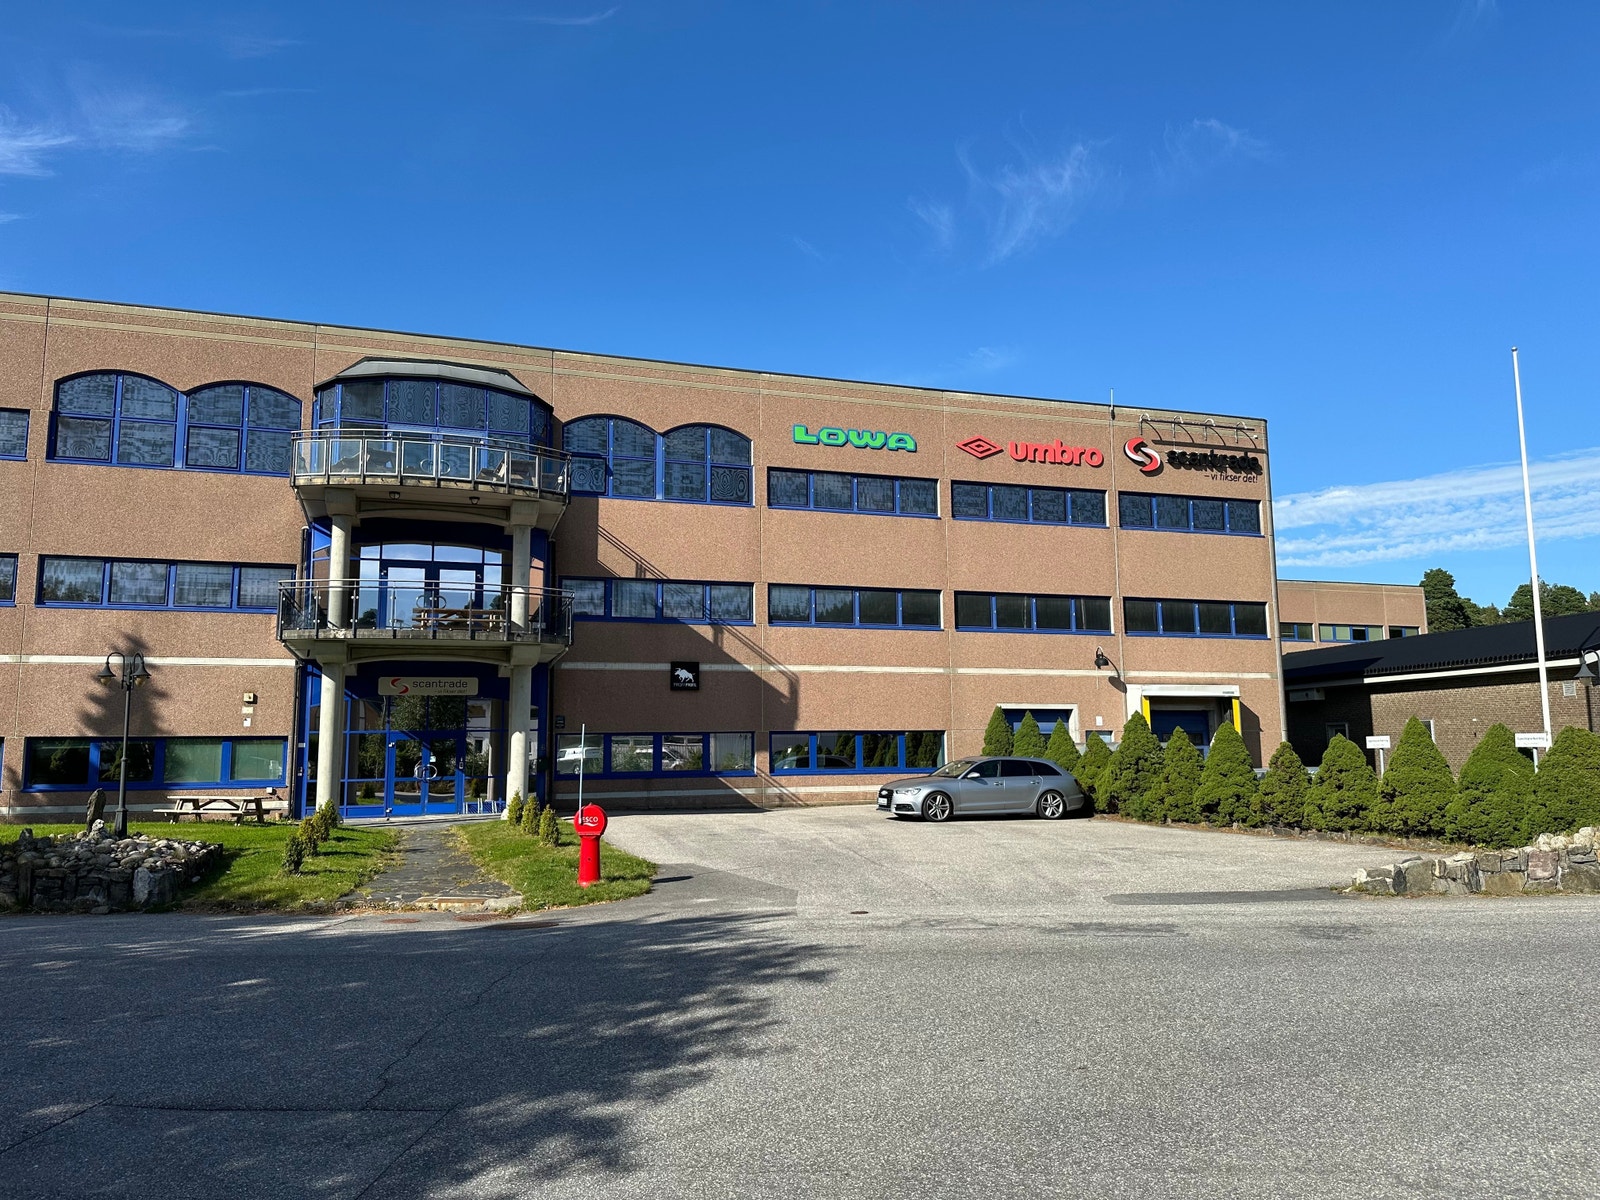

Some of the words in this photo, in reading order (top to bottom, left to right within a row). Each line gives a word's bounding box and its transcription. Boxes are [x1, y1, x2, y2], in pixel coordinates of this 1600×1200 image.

[793, 423, 917, 452] LOWA
[1008, 438, 1104, 468] umbro
[1166, 449, 1260, 471] scantrade
[1219, 473, 1241, 482] fikser
[1242, 475, 1258, 483] det!
[412, 680, 468, 688] scantrade
